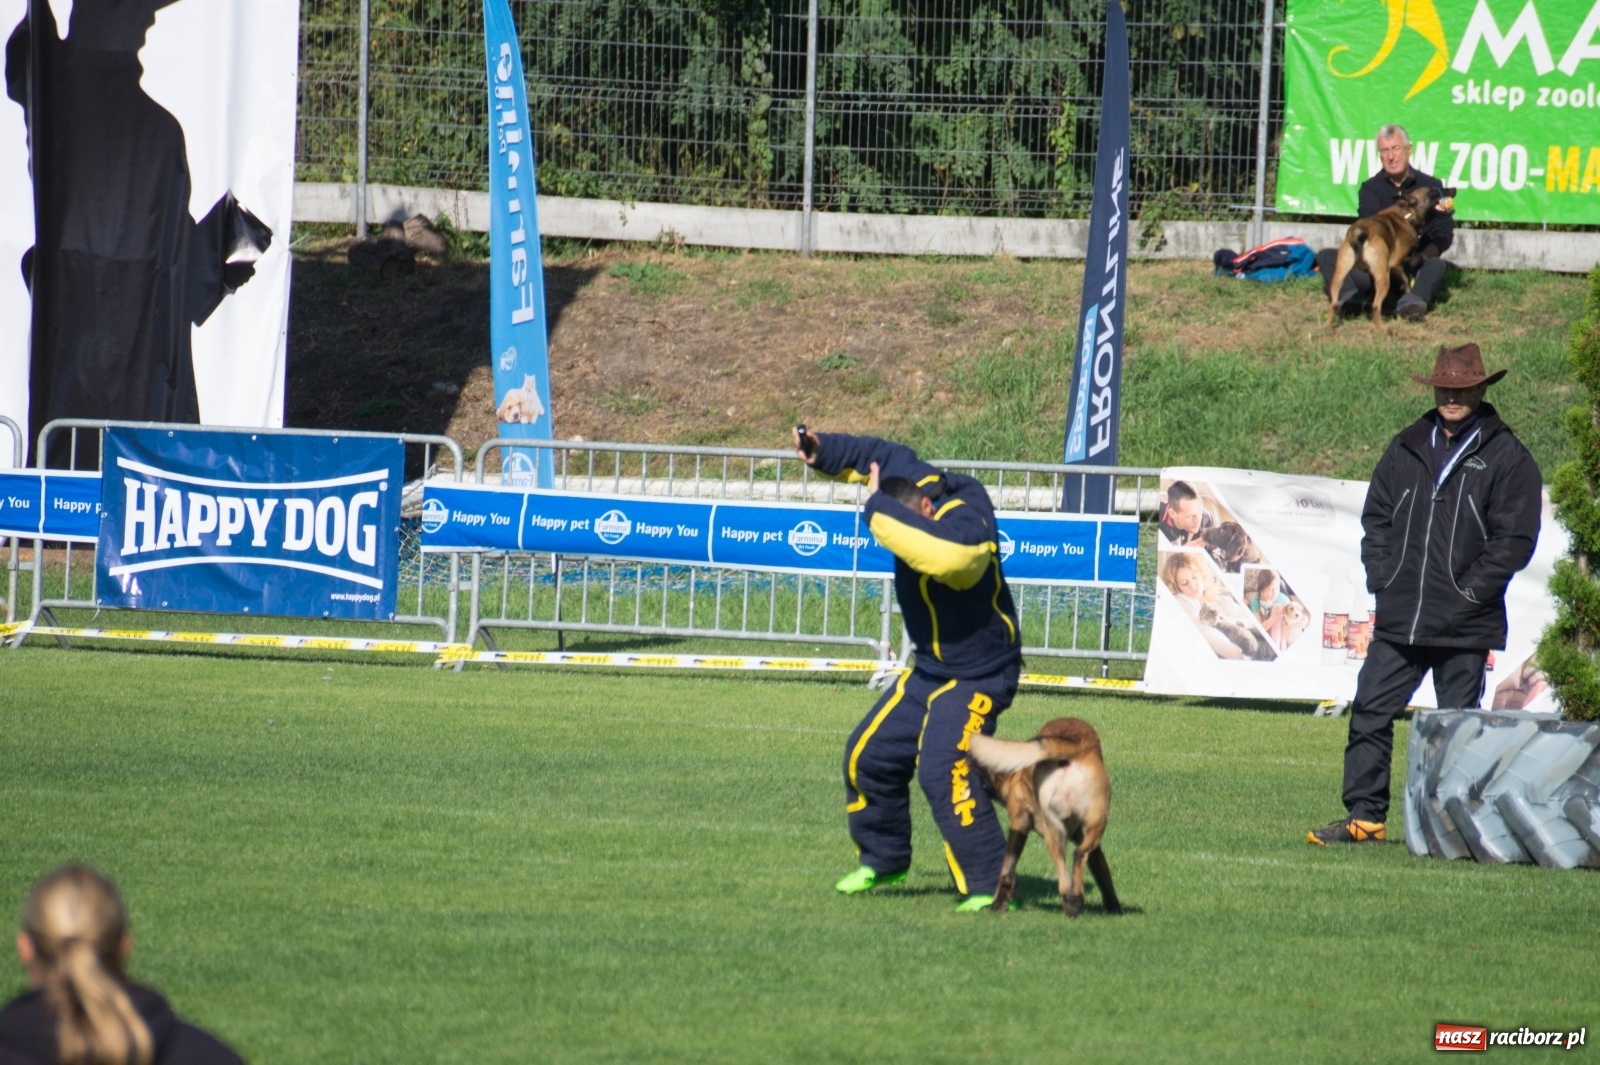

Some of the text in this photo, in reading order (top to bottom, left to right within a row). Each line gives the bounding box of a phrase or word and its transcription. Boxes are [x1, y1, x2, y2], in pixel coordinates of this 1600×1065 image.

[1452, 79, 1525, 112] sklep
[8, 496, 30, 509] You
[53, 497, 92, 514] Happy
[1295, 498, 1309, 508] 10
[120, 477, 379, 567] HAPPY DOG
[452, 510, 487, 527] Happy
[490, 512, 511, 526] You
[531, 514, 699, 538] Happy pet Farmina Happy You
[721, 526, 760, 543] Happy
[763, 530, 783, 544] pet
[792, 533, 824, 544] Farmina
[832, 533, 870, 549] Happy
[1020, 541, 1058, 557] Happy
[1062, 543, 1085, 555] You
[1108, 543, 1138, 560] Happ
[330, 592, 380, 603] www.happydog.pl
